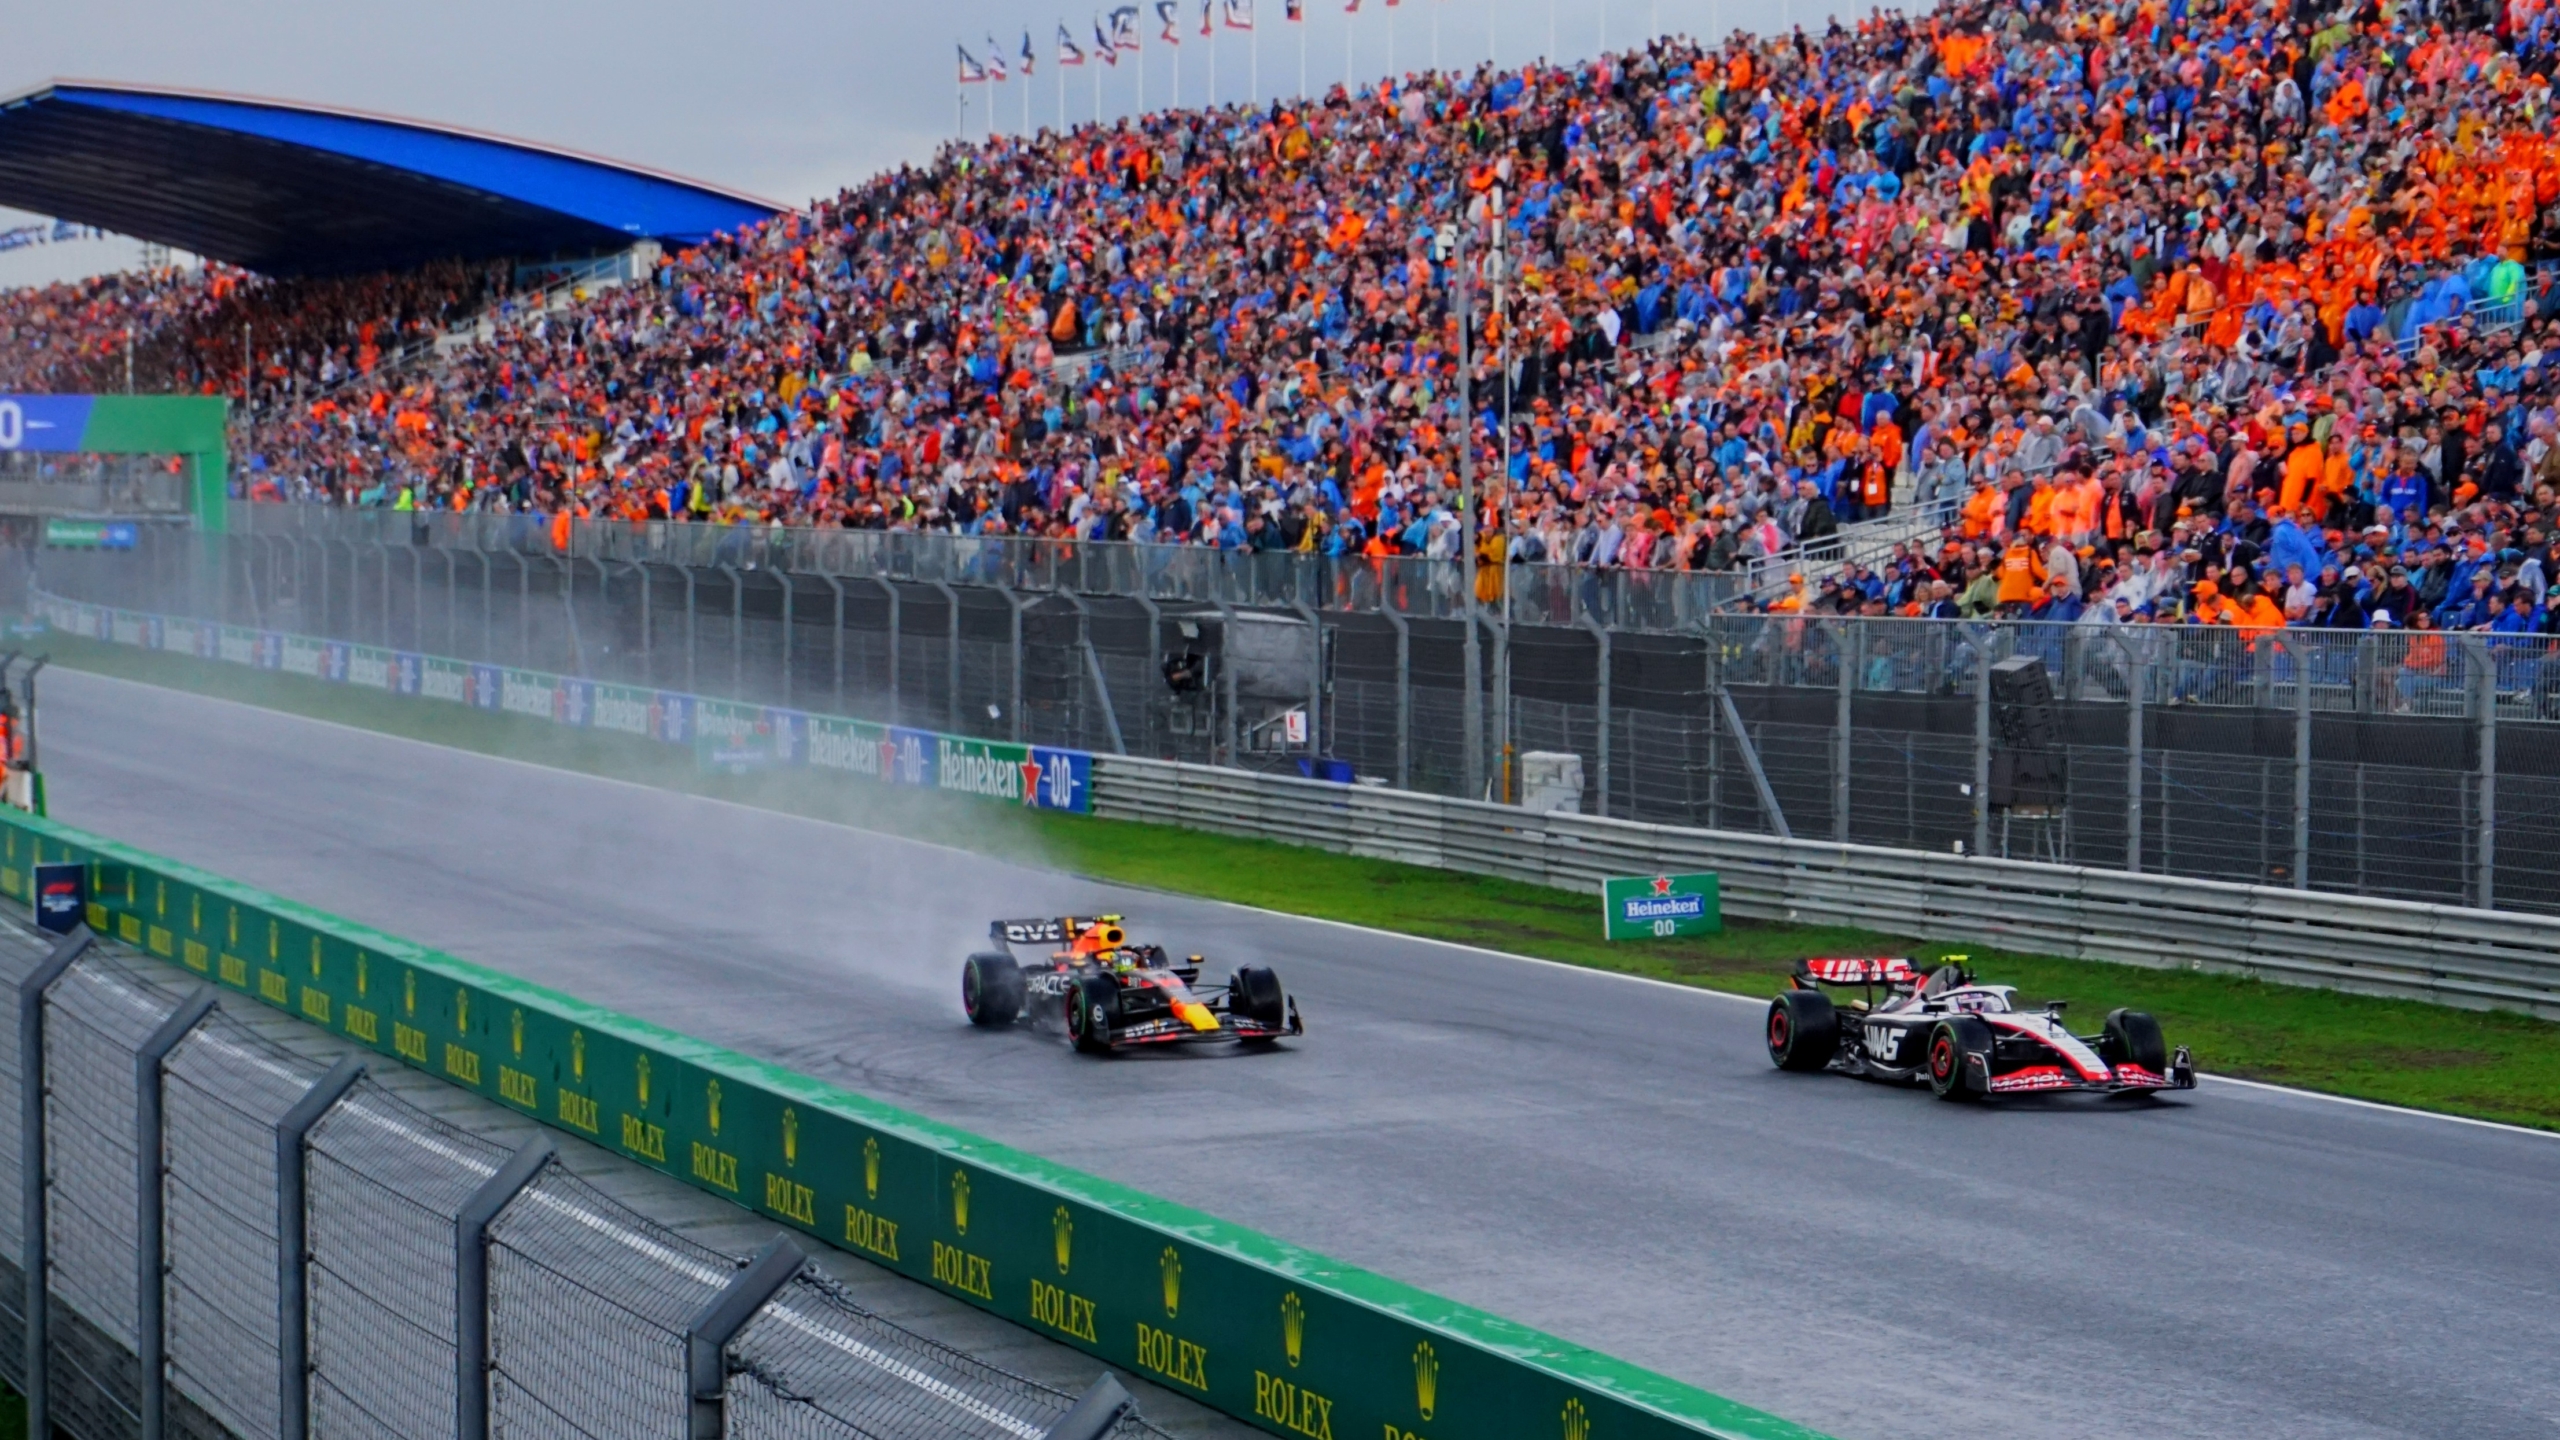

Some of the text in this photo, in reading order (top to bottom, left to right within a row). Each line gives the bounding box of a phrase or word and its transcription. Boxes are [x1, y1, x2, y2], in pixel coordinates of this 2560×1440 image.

[808, 718, 877, 775] Heineken
[939, 739, 1018, 799] Heineken
[1627, 899, 1700, 917] Heineken
[446, 1043, 480, 1085] ROLEX
[500, 1065, 536, 1109] ROLEX
[559, 1089, 597, 1133] ROLEX
[623, 1114, 666, 1162] ROLEX
[692, 1142, 739, 1192] ROLEX
[766, 1173, 815, 1225] ROLEX
[845, 1204, 899, 1261] ROLEX
[932, 1240, 993, 1300] ROLEX
[1031, 1279, 1097, 1343] ROLEX
[1137, 1322, 1208, 1391] ROLEX
[1255, 1370, 1333, 1440] ROLEX
